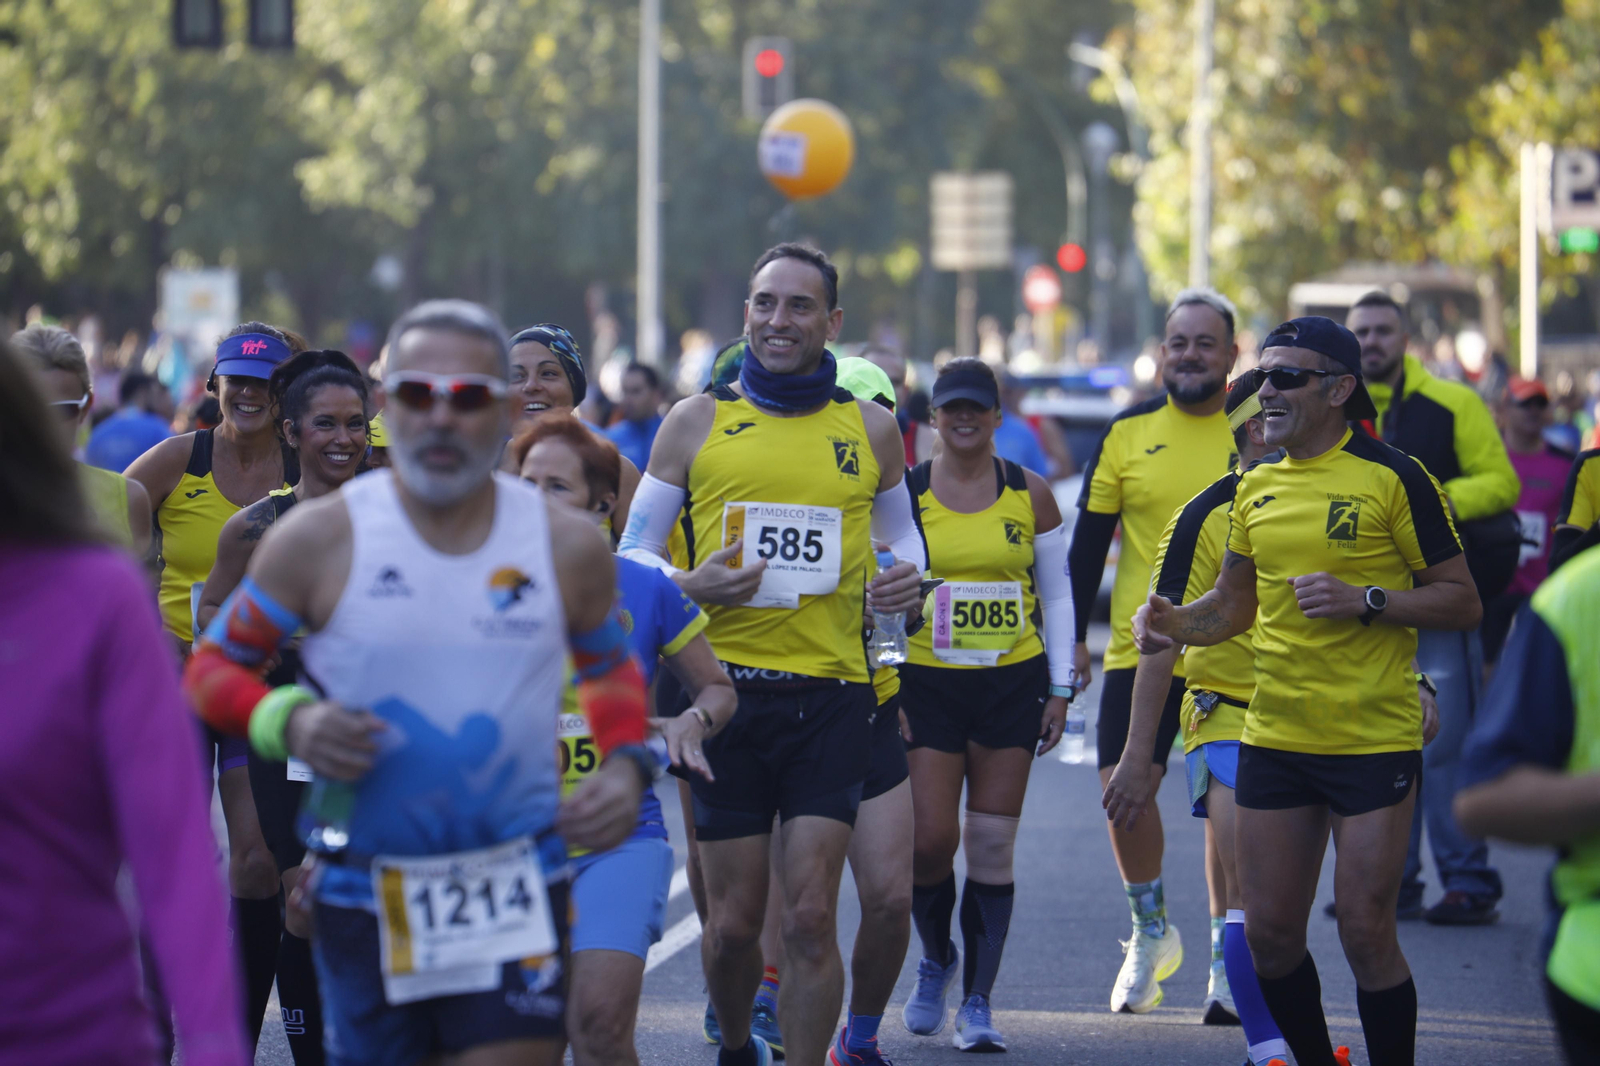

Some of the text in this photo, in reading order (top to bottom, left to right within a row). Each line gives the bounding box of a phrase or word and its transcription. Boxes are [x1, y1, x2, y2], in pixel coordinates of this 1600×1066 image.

[1554, 150, 1598, 205] P
[1327, 493, 1368, 503] Vida Sana
[760, 507, 805, 519] IMDECO
[757, 526, 824, 563] 585
[1327, 541, 1357, 549] y Feliz
[962, 586, 997, 594] IMDECO
[952, 601, 1018, 628] 5085
[411, 877, 534, 930] 1214
